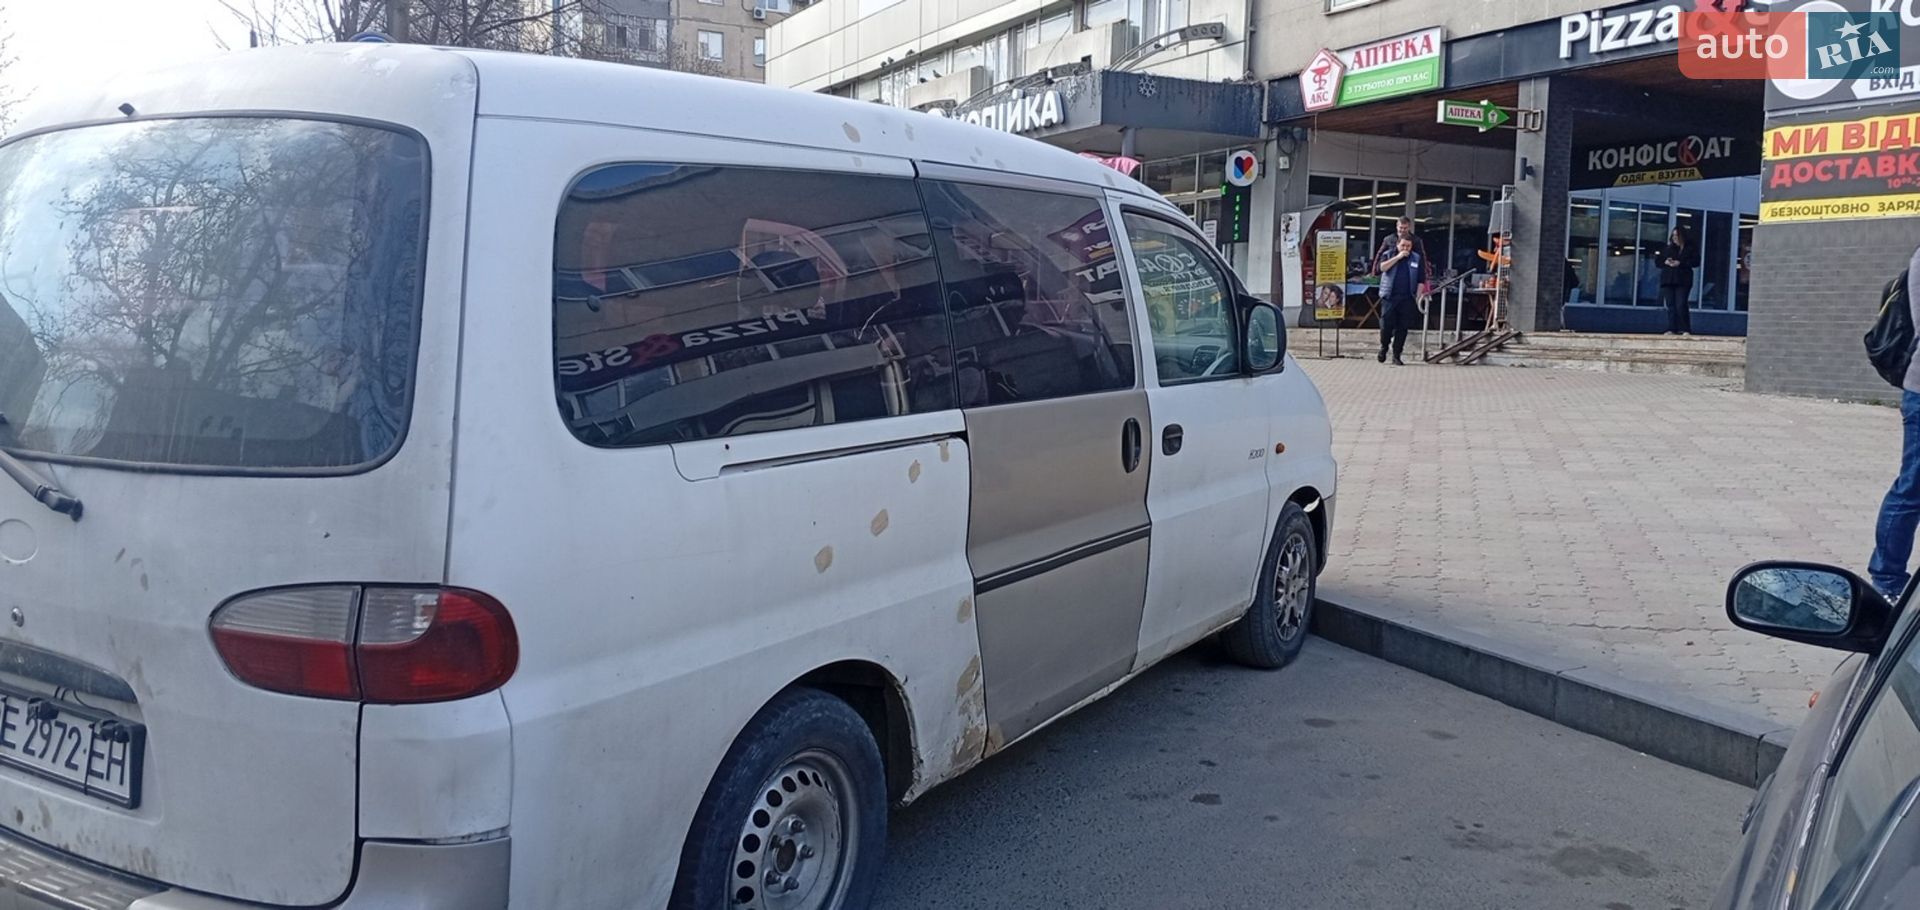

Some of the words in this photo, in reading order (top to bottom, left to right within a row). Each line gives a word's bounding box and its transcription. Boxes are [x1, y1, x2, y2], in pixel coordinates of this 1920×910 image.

[1558, 3, 1681, 59] Pizza
[1351, 35, 1433, 70] АПТЕКА
[951, 88, 1063, 133] ОПІЙКА
[1309, 90, 1329, 104] АКС
[1448, 106, 1482, 119] АПТЕКА
[1588, 134, 1735, 171] КОНФІСКАТ
[1772, 126, 1829, 157] МИ
[1620, 173, 1647, 184] ОДЯГ
[1658, 169, 1695, 180] ВЗУТТЯ
[1771, 202, 1870, 218] БЕЗКОШТОВНО
[22, 709, 81, 771] 2972
[87, 729, 127, 786] EH
